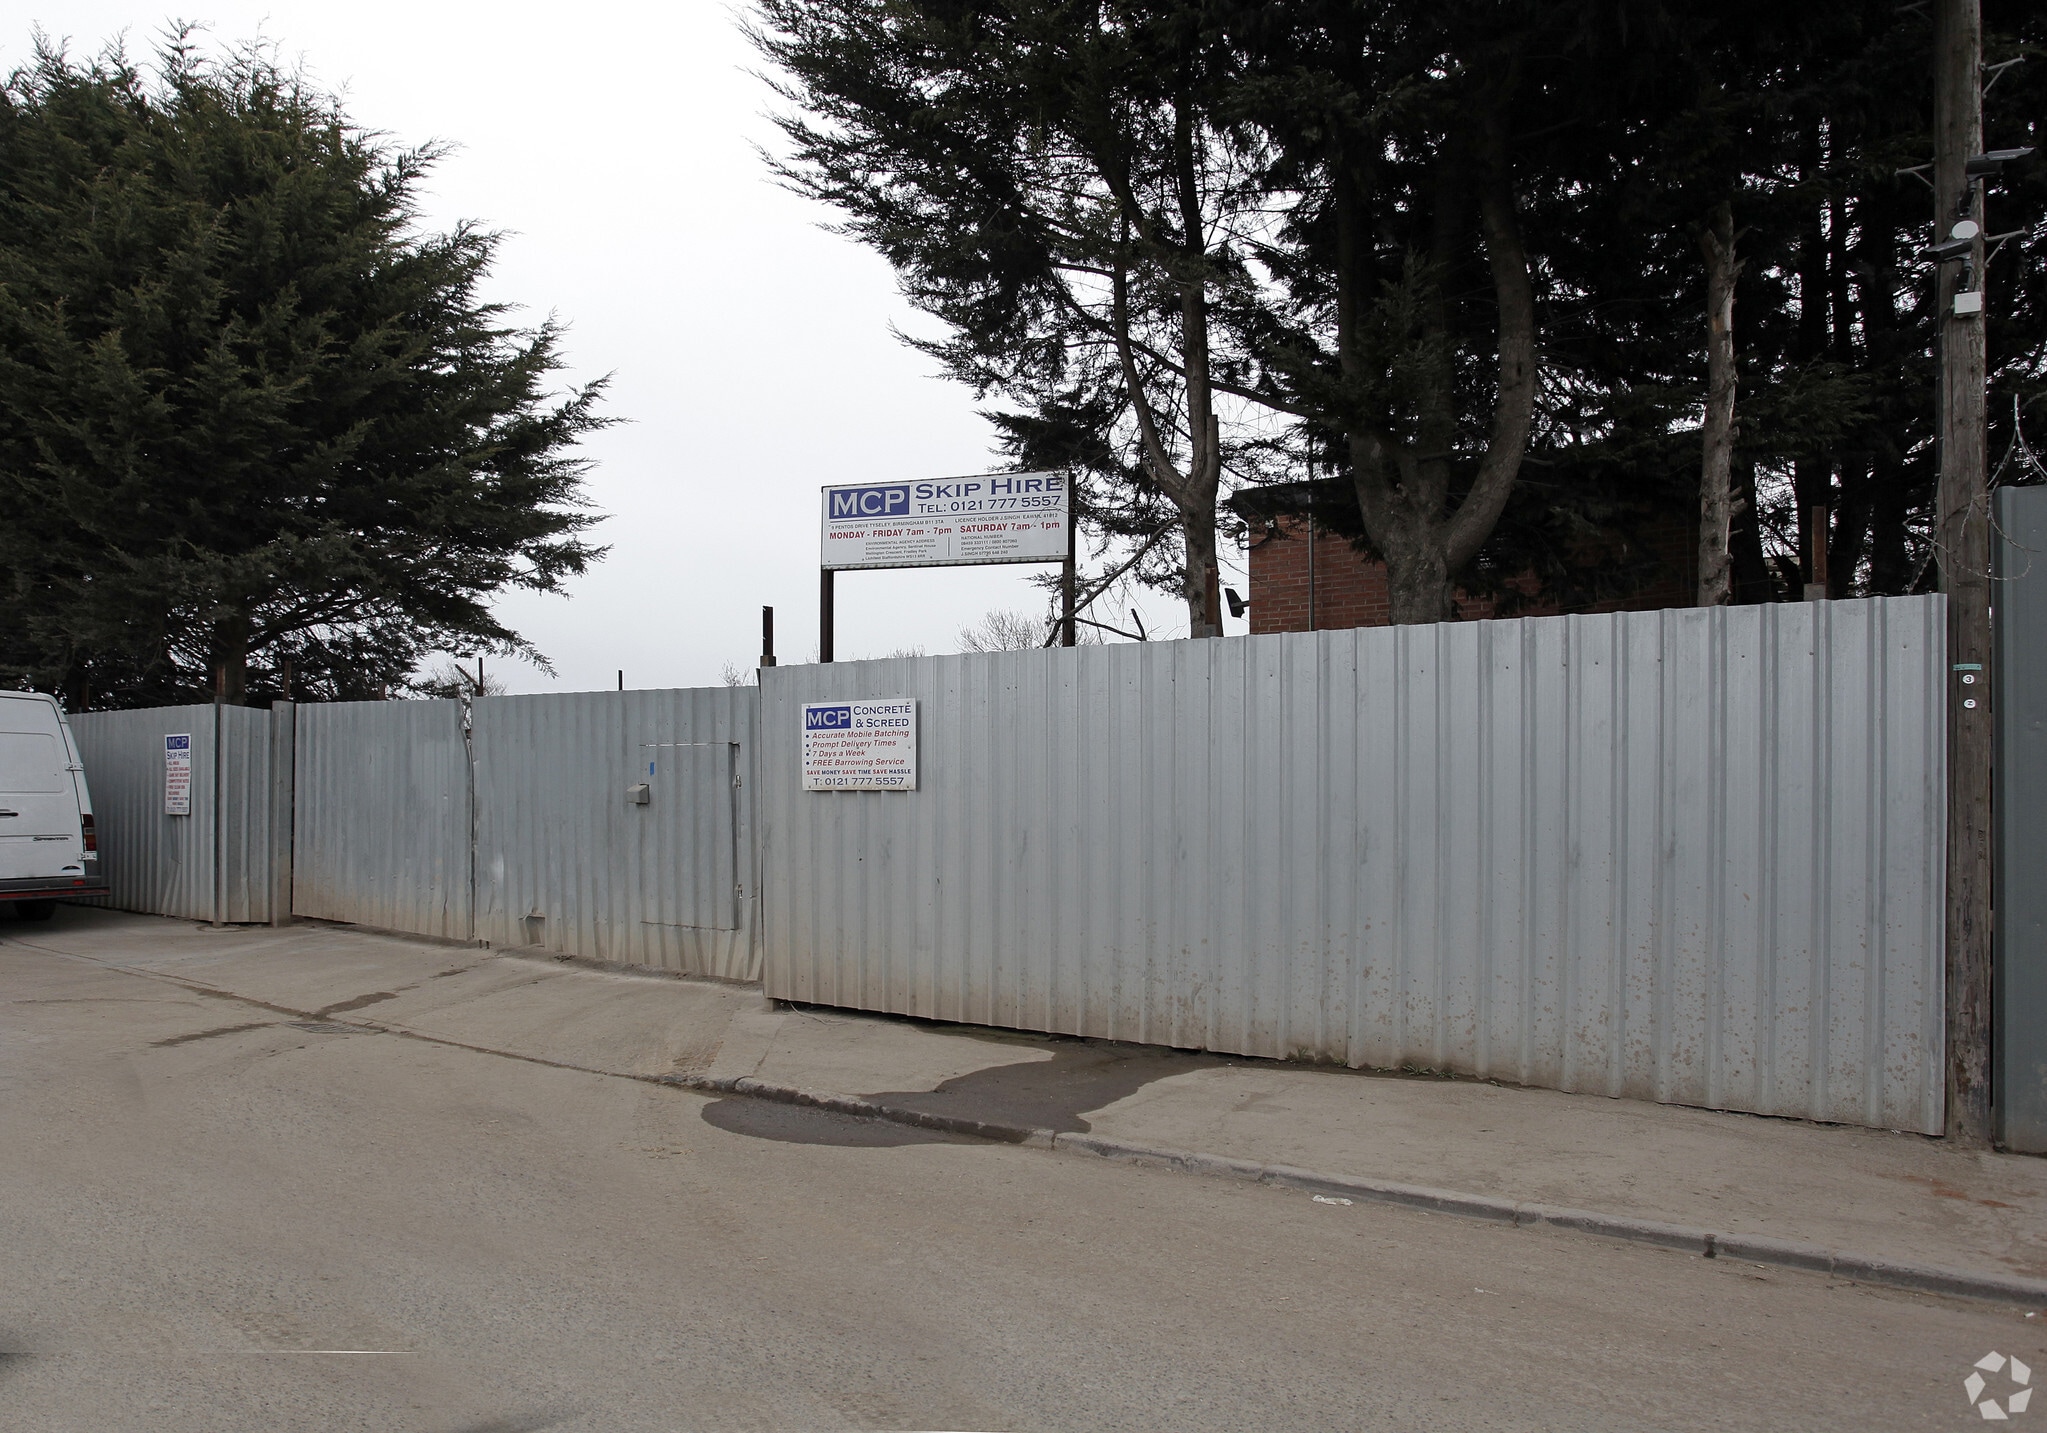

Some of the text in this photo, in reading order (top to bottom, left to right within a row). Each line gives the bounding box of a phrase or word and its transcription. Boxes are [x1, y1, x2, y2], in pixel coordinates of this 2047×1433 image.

[916, 477, 1063, 499] SKIP HIRE
[834, 490, 905, 516] MCP
[918, 496, 1061, 513] TEL: 0121 777 5557
[960, 523, 1007, 533] SATURDAY
[1041, 522, 1060, 530] 1pm
[829, 530, 865, 540] MONDAY
[873, 529, 903, 537] FRIDAY
[933, 526, 952, 536] 7pm
[854, 705, 911, 715] CONCRETE
[808, 710, 850, 726] MCP
[866, 719, 909, 728] SCREED
[874, 730, 909, 738] Batching
[168, 738, 188, 748] MCP
[167, 750, 189, 759] SKIP HIRE
[835, 759, 873, 767] Barrowing
